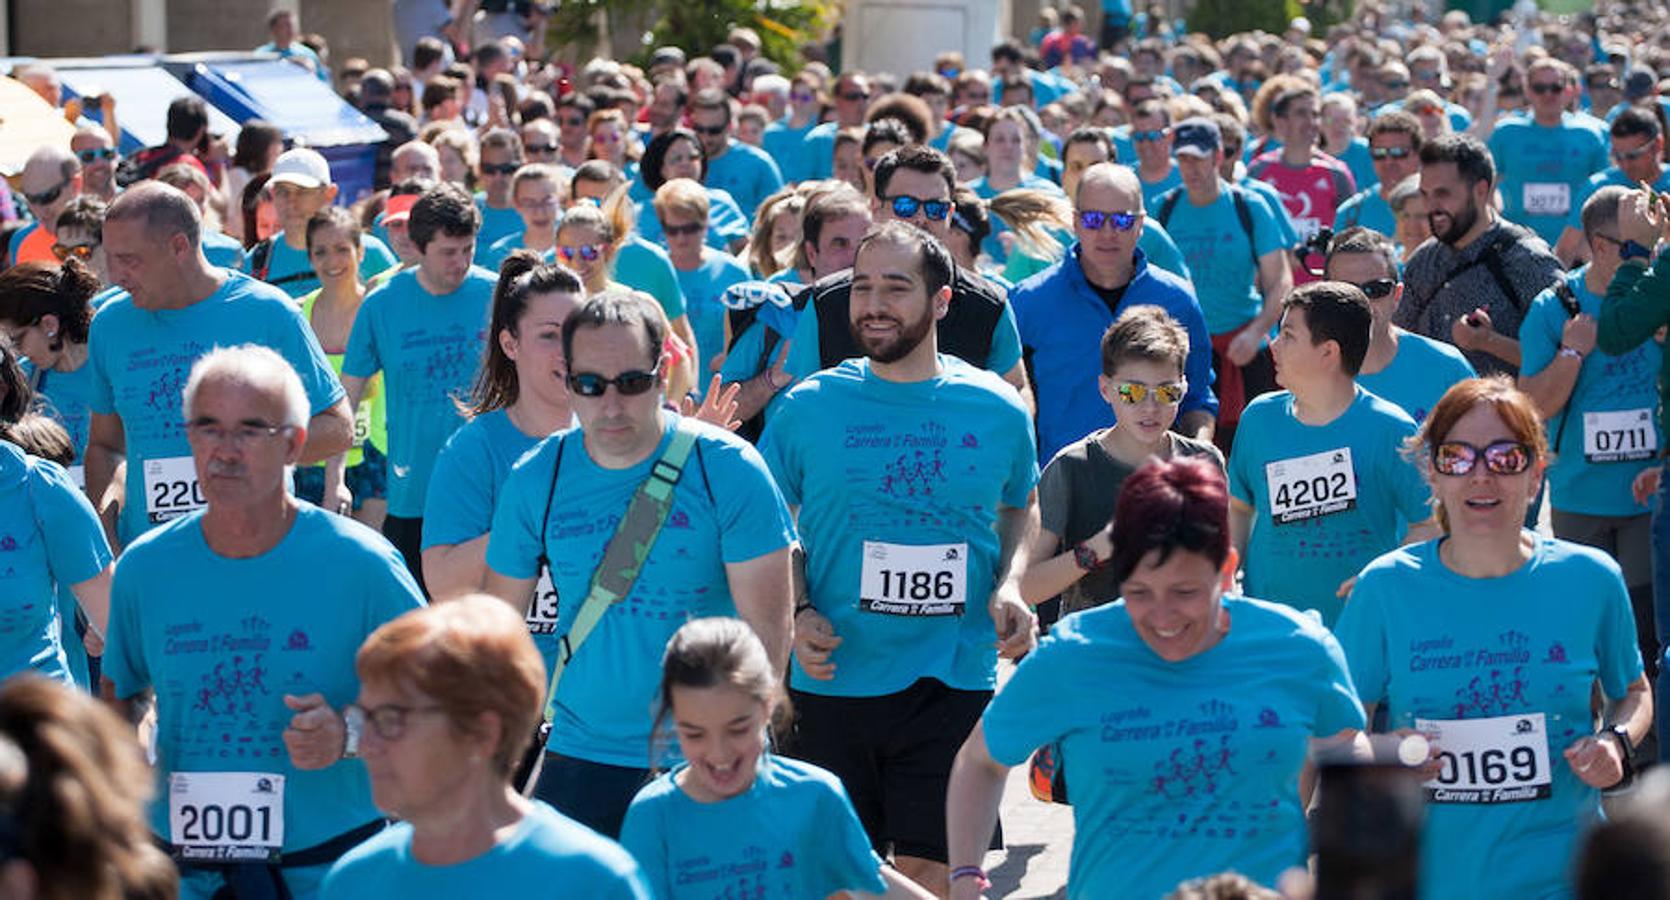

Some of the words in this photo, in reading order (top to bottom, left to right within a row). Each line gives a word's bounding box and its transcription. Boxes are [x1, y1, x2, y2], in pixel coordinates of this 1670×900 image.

[845, 434, 891, 448] Carrera
[903, 434, 948, 448] Familia
[1596, 428, 1646, 451] 0711
[1275, 472, 1349, 508] 4202
[880, 569, 953, 601] 1186
[870, 600, 908, 614] Carrera
[1410, 654, 1462, 672] Carrera
[1475, 648, 1531, 667] Familia
[1101, 724, 1161, 742] Carrera
[1176, 718, 1239, 737] Familia
[1433, 745, 1537, 785] 0169
[1434, 788, 1480, 801] Carrera
[1491, 785, 1538, 801] Familia
[181, 804, 270, 842] 2001
